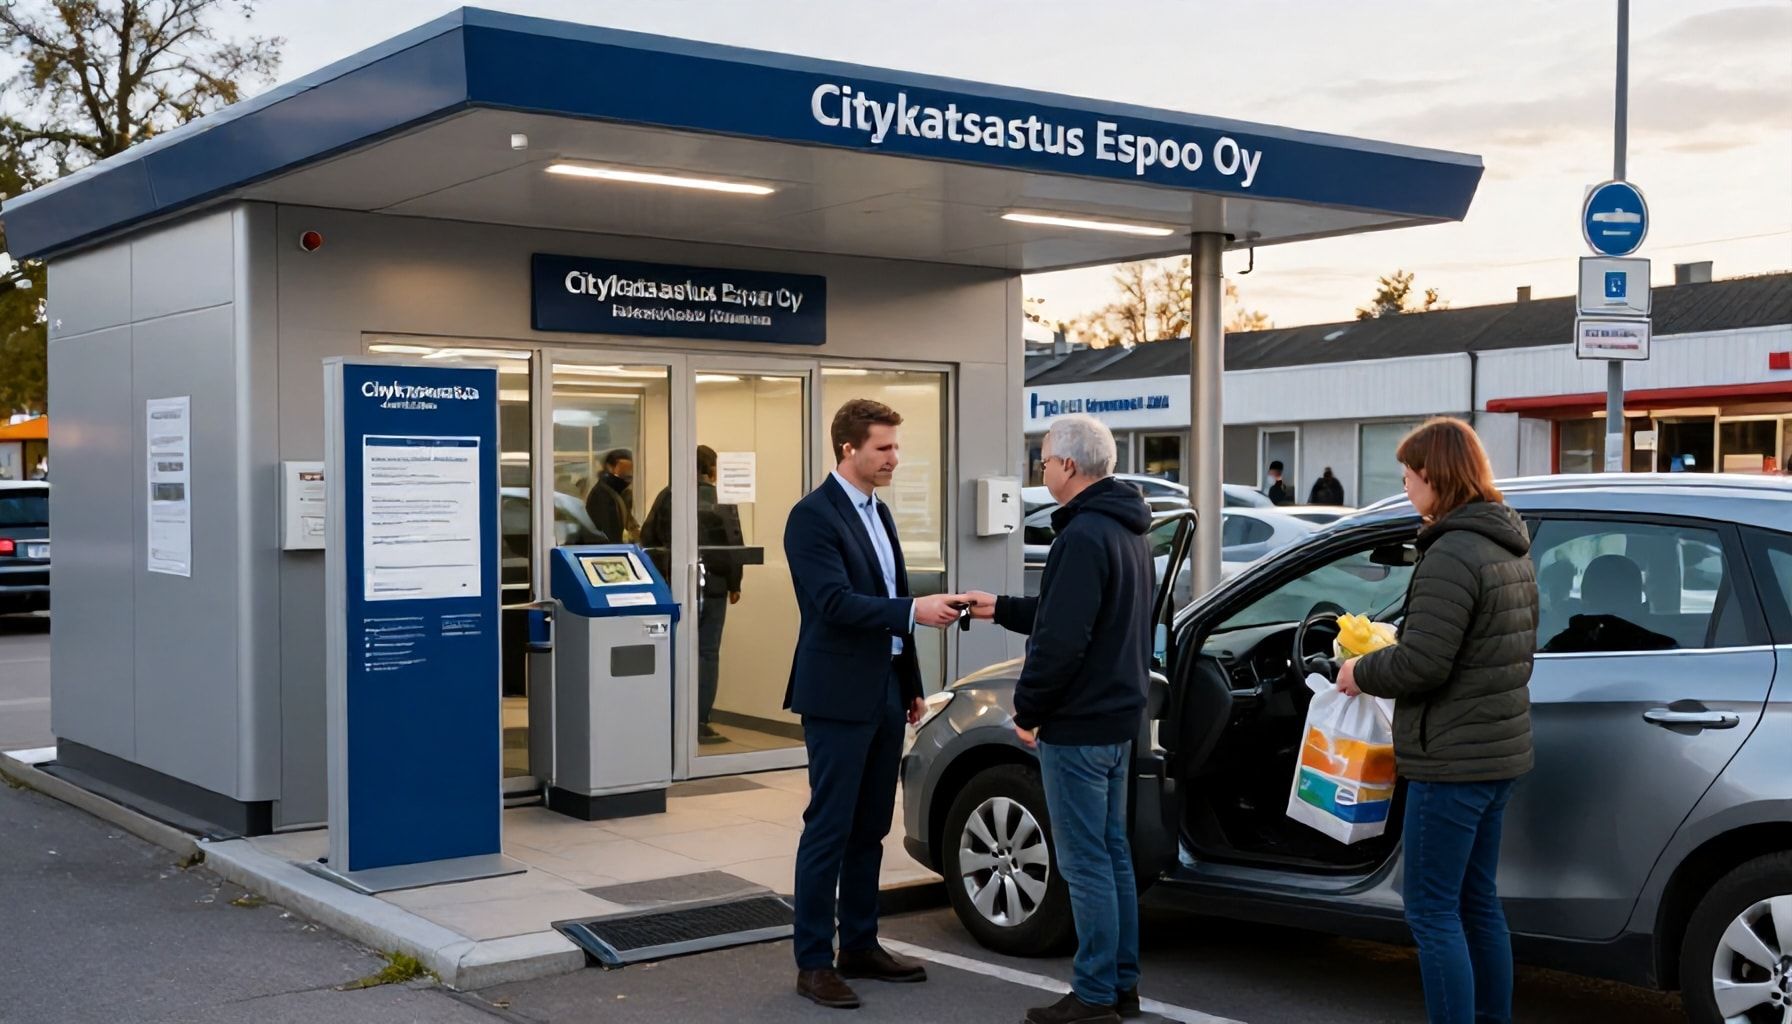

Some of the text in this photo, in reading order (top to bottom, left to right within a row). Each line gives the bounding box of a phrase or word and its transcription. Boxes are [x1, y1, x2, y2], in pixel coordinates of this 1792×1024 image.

[811, 83, 1262, 188] Citykatsastus Espoo Oy
